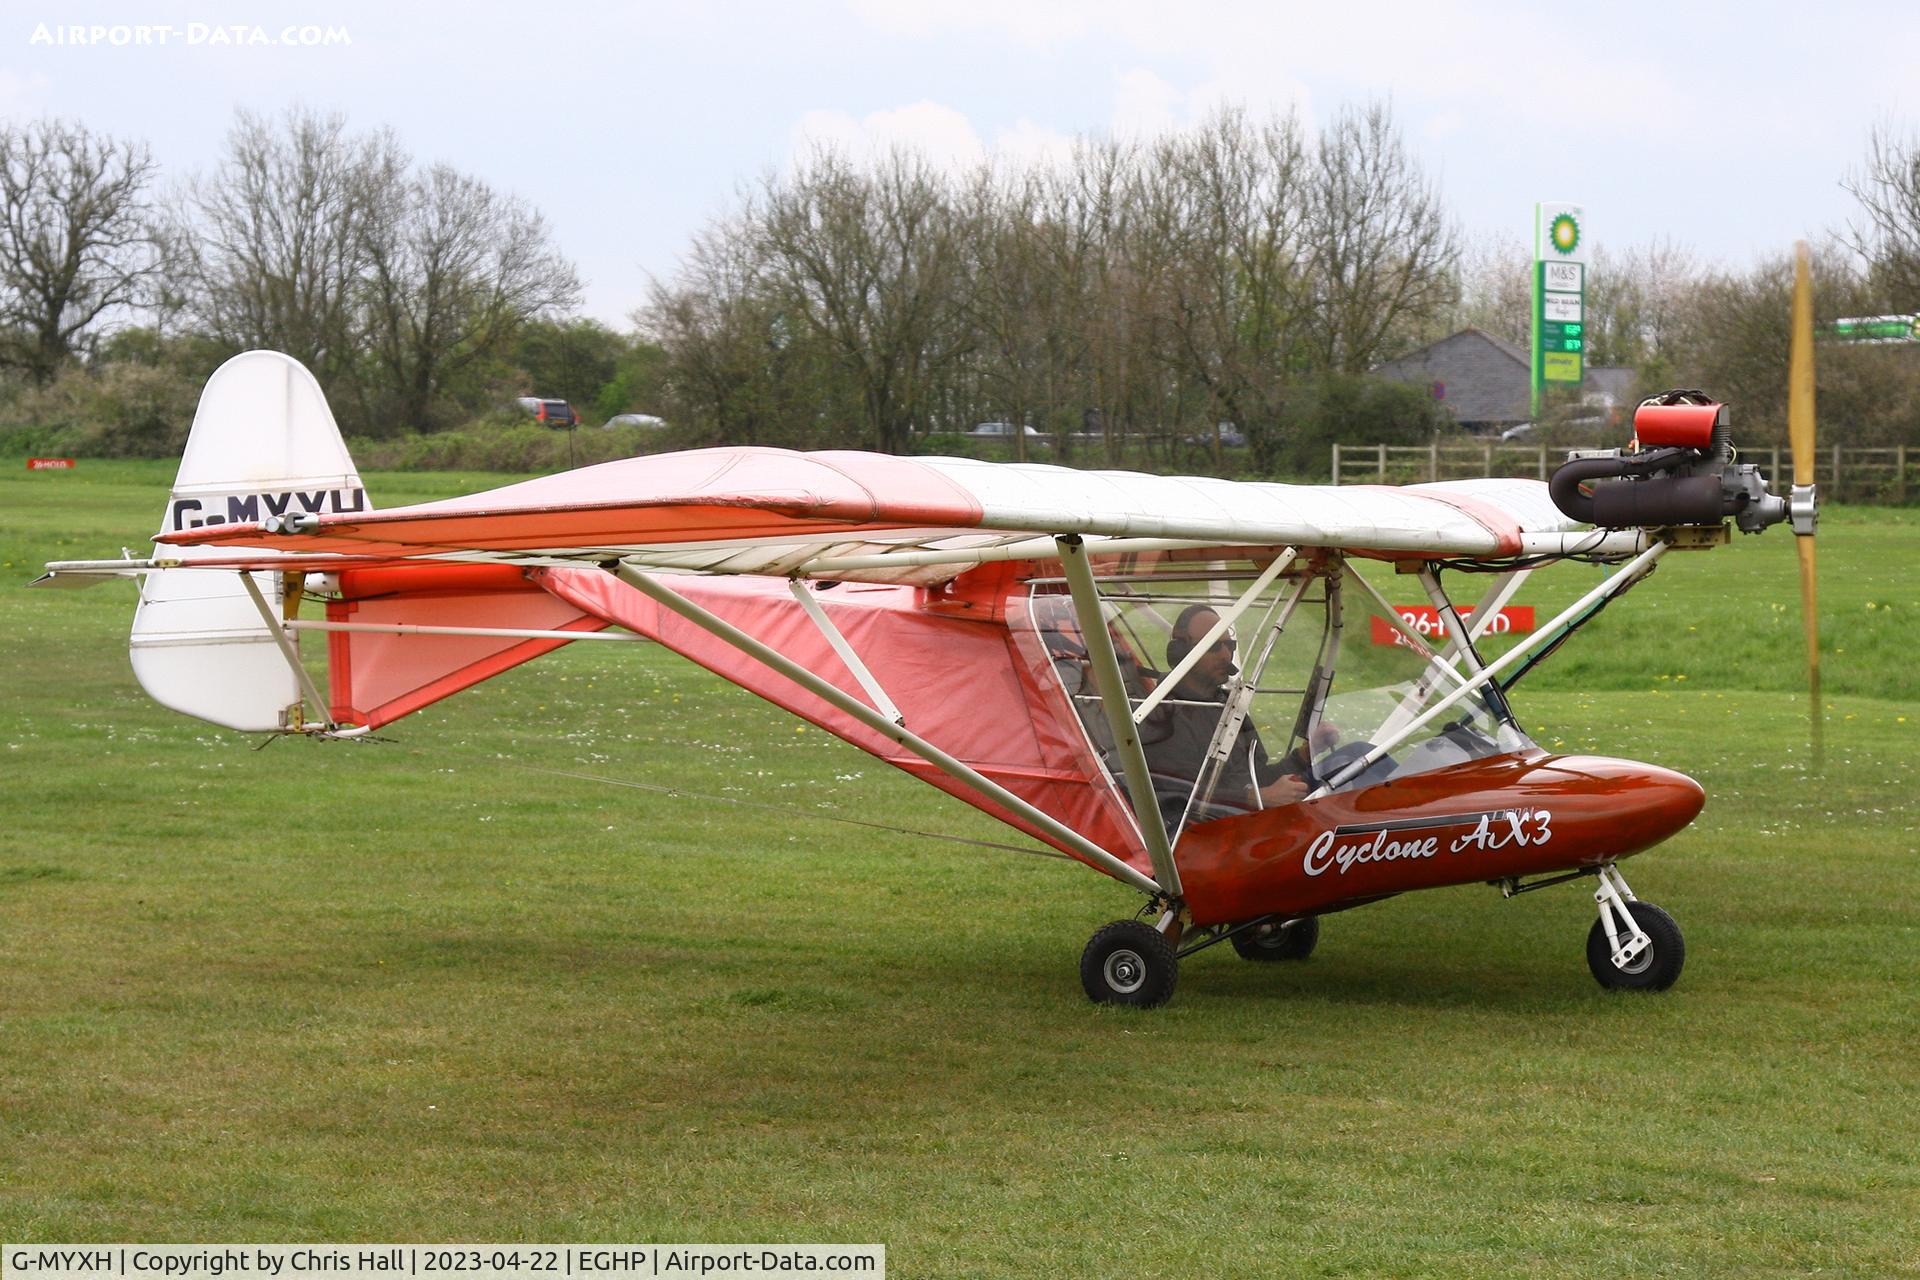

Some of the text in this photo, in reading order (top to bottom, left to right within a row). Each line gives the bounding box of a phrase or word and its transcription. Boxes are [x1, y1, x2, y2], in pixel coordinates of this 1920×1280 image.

[1551, 266, 1576, 280] M&S
[1303, 810, 1552, 876] Cyclone AX3
